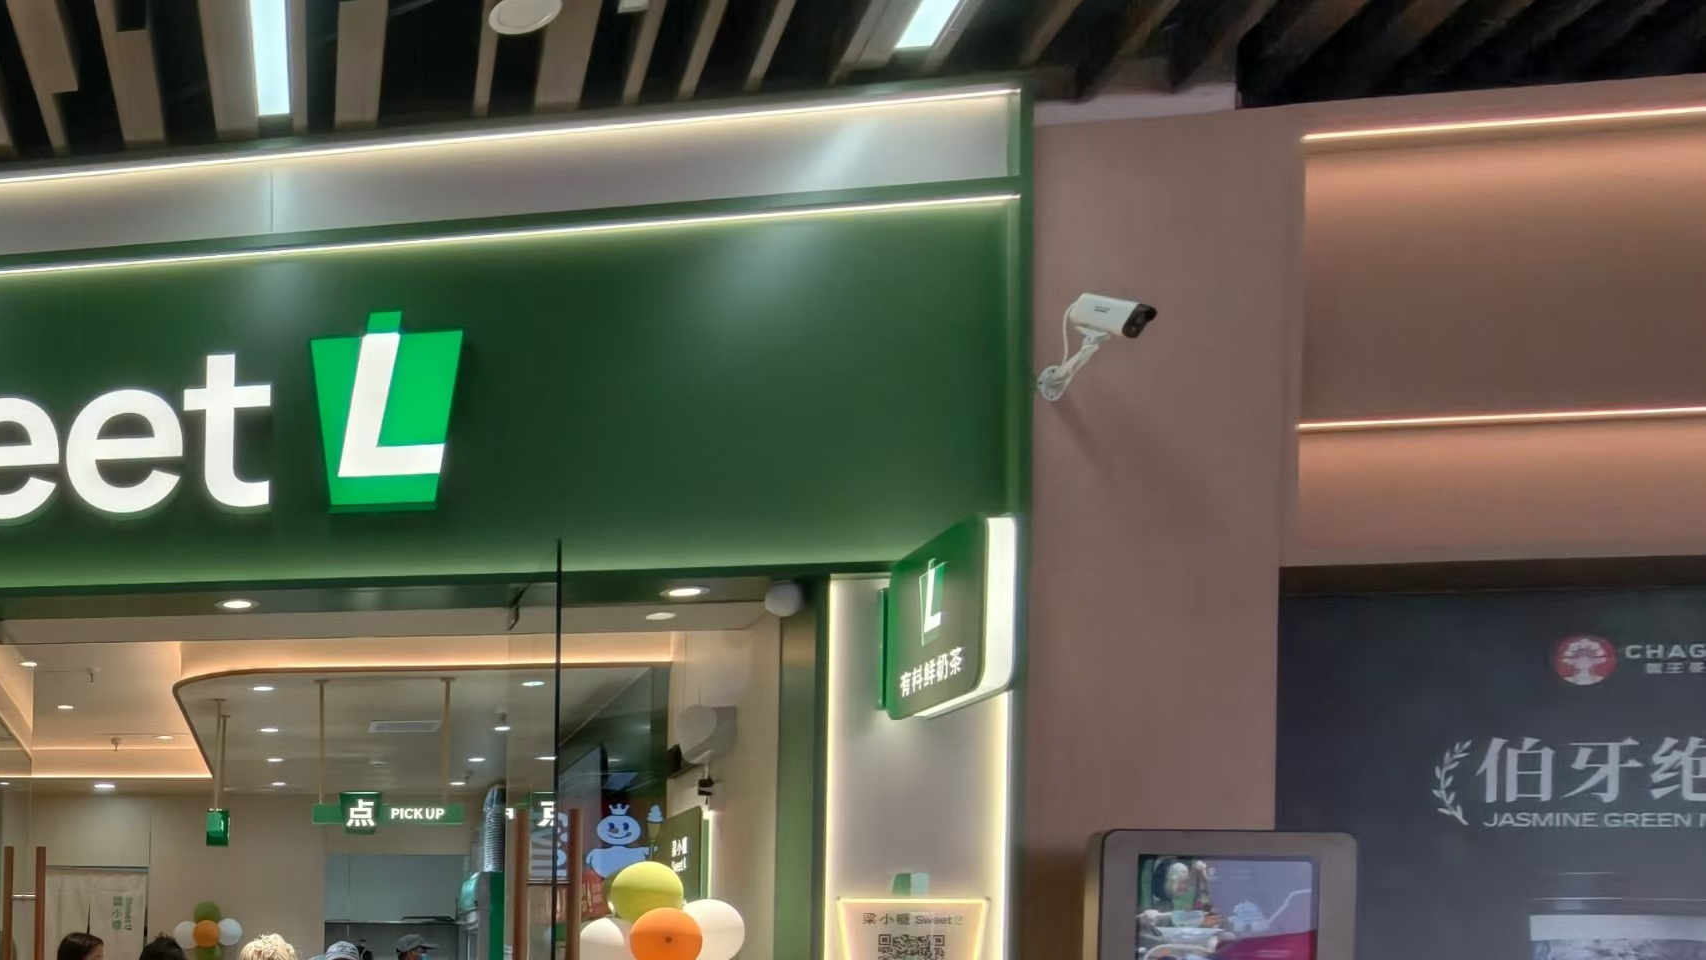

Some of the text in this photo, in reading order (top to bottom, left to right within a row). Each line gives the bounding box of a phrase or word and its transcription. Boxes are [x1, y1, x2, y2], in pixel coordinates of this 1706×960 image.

[900, 646, 963, 698] 有料鲜奶茶
[1476, 737, 1706, 804] 伯牙绝
[347, 798, 445, 827] 点 PICK UP
[1483, 812, 1694, 828] JASMINE GREEN
